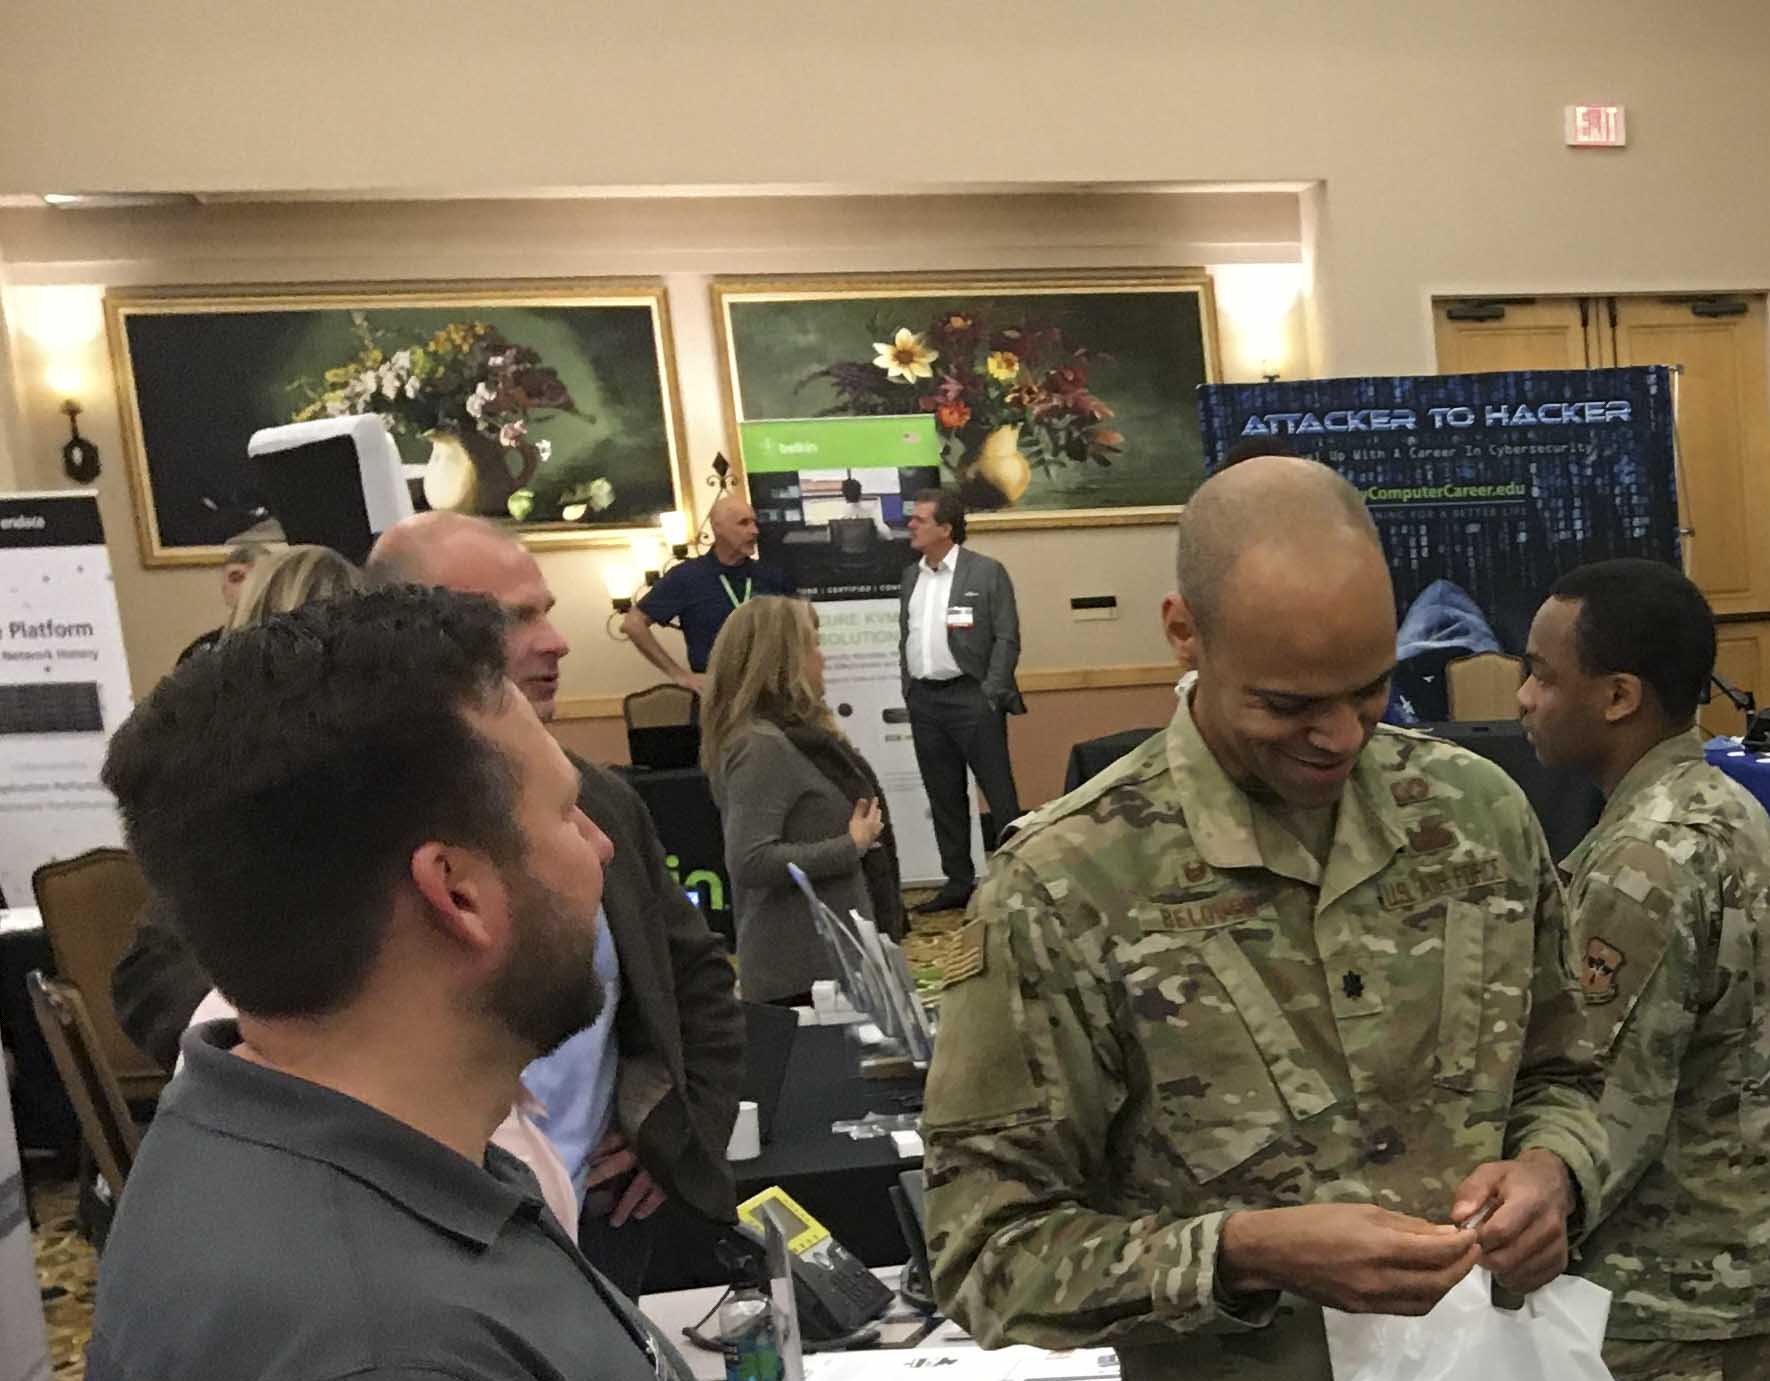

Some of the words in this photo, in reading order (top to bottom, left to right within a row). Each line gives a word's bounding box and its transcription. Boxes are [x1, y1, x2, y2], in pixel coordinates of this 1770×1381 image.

[1575, 106, 1617, 142] EXIT
[1241, 409, 1417, 436] ATTACKER
[1428, 406, 1475, 429] TO
[1484, 400, 1632, 427] HACKER
[1359, 481, 1526, 501] yComputerCareer.edu
[8, 618, 94, 639] Platform
